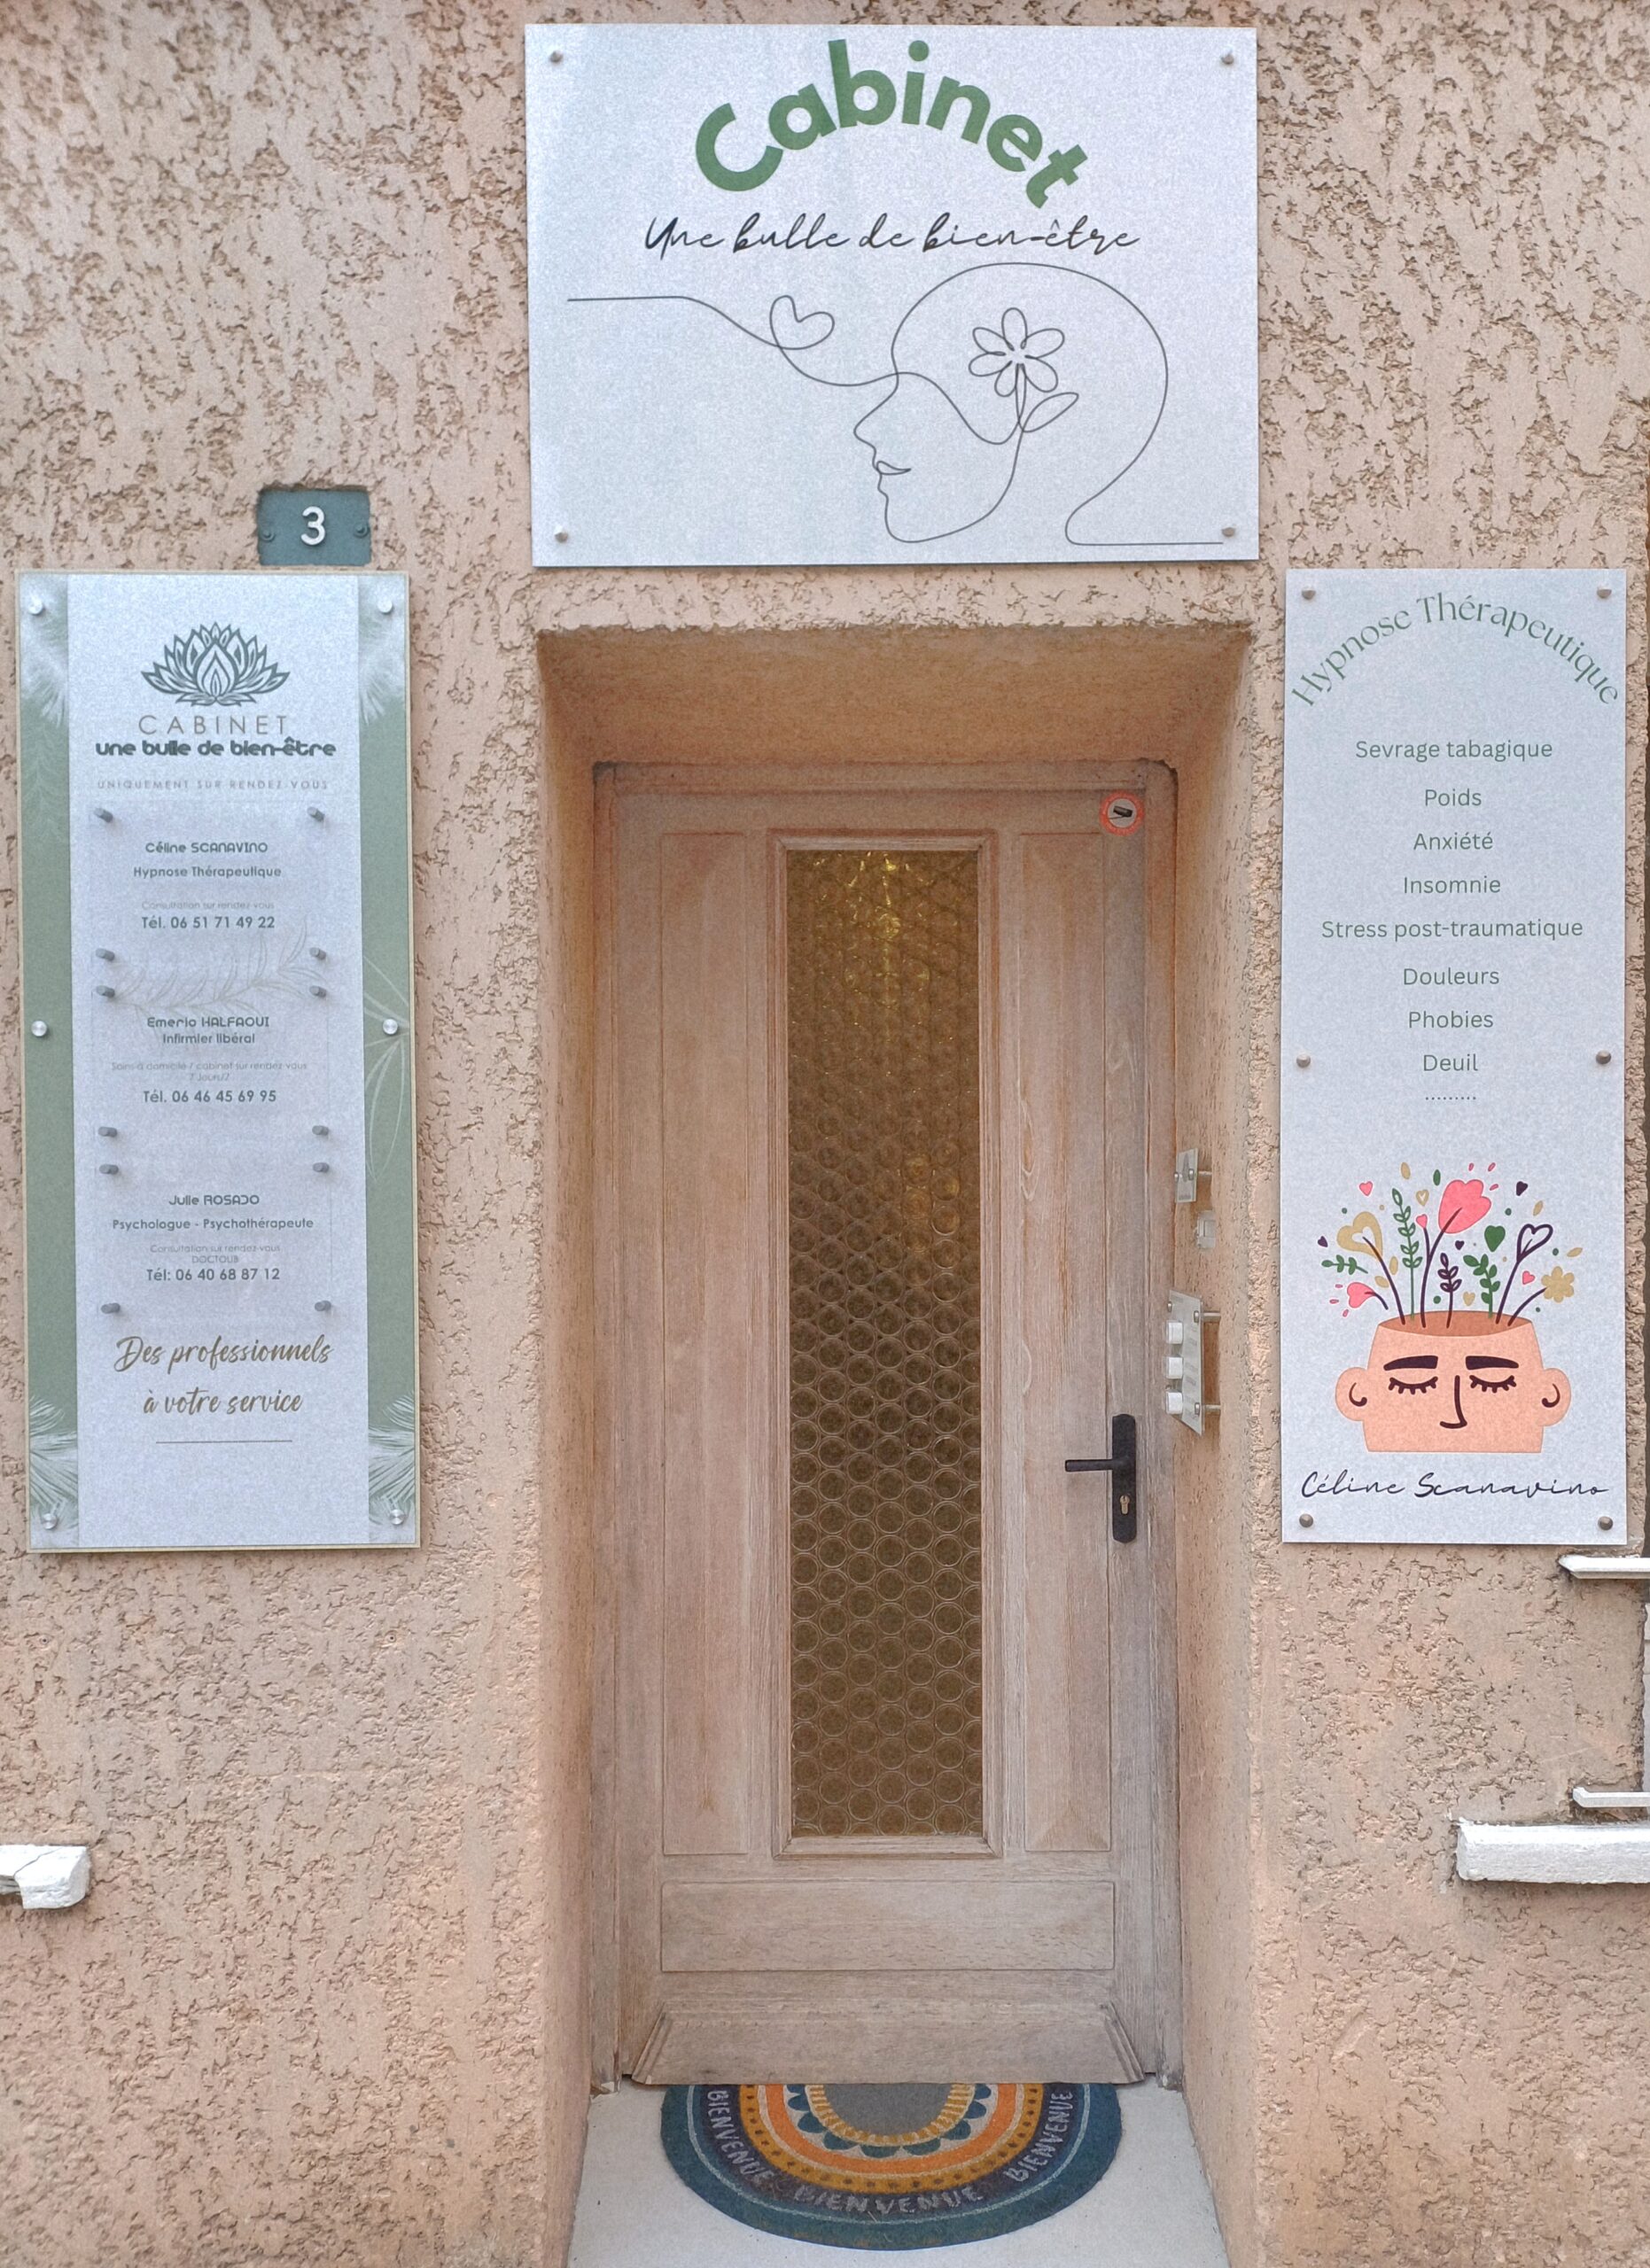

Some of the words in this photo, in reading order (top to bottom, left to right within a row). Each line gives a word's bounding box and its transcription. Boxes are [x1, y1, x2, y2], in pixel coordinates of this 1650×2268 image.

[696, 39, 1088, 208] Cabinet
[645, 217, 724, 260] Une
[733, 213, 850, 252] bulle
[860, 214, 914, 249] de
[922, 213, 1140, 255] bien-être
[301, 506, 325, 545] 3
[1291, 610, 1413, 706] Hypnose
[1416, 592, 1618, 704] Thérapeutique
[138, 715, 287, 734] CABINET
[95, 742, 136, 756] une
[142, 740, 191, 756] bulle
[197, 740, 224, 756] de
[230, 735, 337, 756] bien-être
[1356, 740, 1440, 763] Sevrage
[1446, 739, 1553, 762] tabagique
[97, 780, 189, 790] UNIQUEMENT
[197, 780, 222, 790] SUR
[1424, 788, 1482, 807] Poids
[145, 841, 187, 853] Céline
[191, 843, 269, 853] SCANAVINO
[1413, 832, 1494, 850] Anxiété
[133, 866, 188, 879] Hypnose
[191, 865, 282, 879] Thérapeutique
[1404, 875, 1501, 894] Insomnie
[142, 915, 166, 929] Tél.
[170, 916, 188, 928] 06
[192, 916, 208, 928] 51
[214, 916, 230, 928] 71
[236, 916, 253, 928] 49
[258, 916, 276, 928] 22
[1321, 920, 1388, 939] Stress
[1395, 919, 1584, 942] post-traumatique
[1403, 967, 1499, 986] Douleurs
[201, 1016, 270, 1028] HALFAOUI
[1408, 1010, 1494, 1029] Phobies
[163, 1033, 213, 1044] Infirmier
[216, 1032, 255, 1044] libéral
[1423, 1053, 1478, 1072] Deuil
[143, 1090, 167, 1103] Tél.
[171, 1090, 189, 1102] 06
[193, 1090, 211, 1102] 46
[215, 1090, 233, 1102] 45
[237, 1090, 254, 1102] 69
[260, 1090, 276, 1101] 95
[168, 1195, 199, 1206] Julie
[203, 1195, 260, 1206] ROSADO
[113, 1219, 191, 1231] Psychologue
[203, 1217, 314, 1231] Psychothérapeute
[175, 1269, 192, 1281] 06
[197, 1269, 214, 1281] 40
[219, 1269, 237, 1281] 68
[241, 1269, 258, 1280] 87
[264, 1268, 281, 1280] 12
[113, 1335, 167, 1372] Des
[167, 1333, 334, 1374] professionnels
[143, 1389, 158, 1413] à
[164, 1386, 221, 1415] votre
[227, 1389, 304, 1415] service
[1301, 1469, 1405, 1498] Céline
[1413, 1472, 1609, 1498] Scanavino
[707, 2090, 776, 2181] BIENVENUE
[1005, 2091, 1074, 2182] BIENVENUE
[794, 2186, 983, 2214] BIENVENUE
